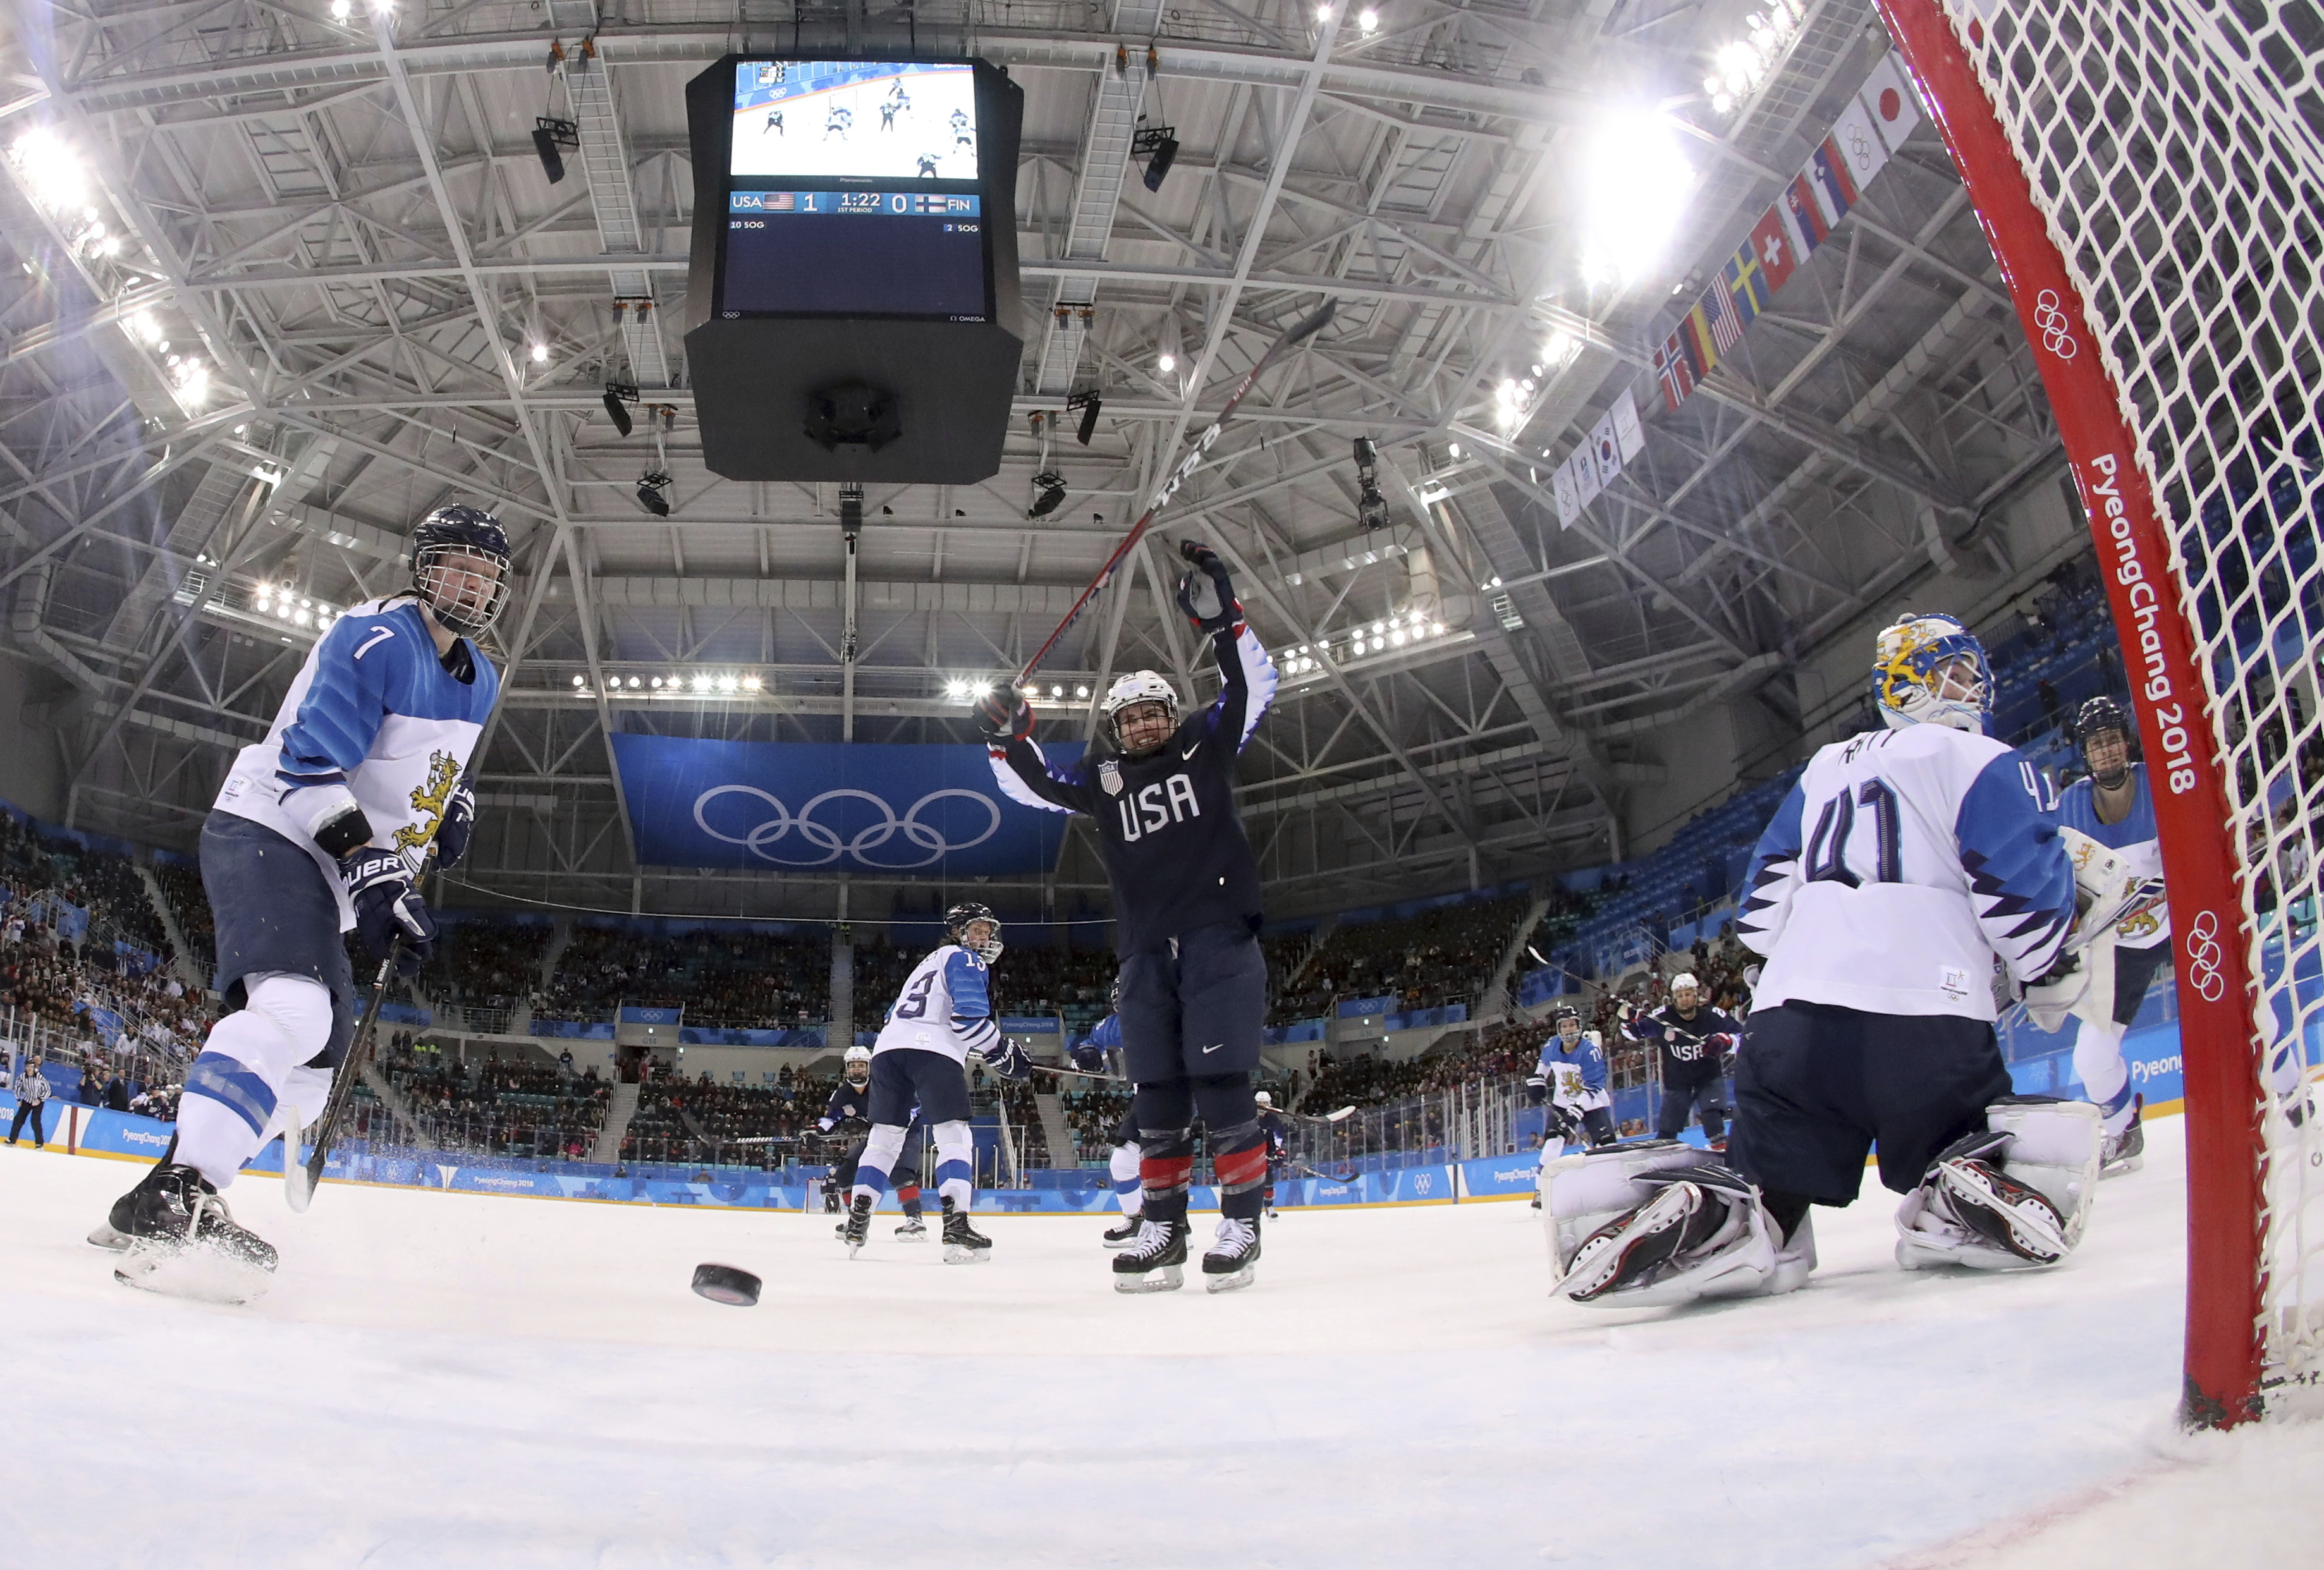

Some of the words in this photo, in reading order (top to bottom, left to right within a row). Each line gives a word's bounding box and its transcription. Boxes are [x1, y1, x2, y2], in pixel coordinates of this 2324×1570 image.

[733, 196, 762, 208] USA
[803, 193, 817, 212] 1
[841, 193, 881, 207] 1:22
[891, 194, 907, 214] 0
[948, 199, 971, 211] FIN
[2091, 453, 2172, 702] PyeongChang
[2155, 702, 2196, 794] 2018
[353, 626, 396, 660] 7
[1101, 765, 1115, 774] USA
[2018, 761, 2060, 812] 41
[1118, 774, 1201, 842] USA
[1805, 776, 1903, 890] 41
[963, 952, 987, 971] 13
[884, 970, 939, 1025] 3
[123, 1128, 161, 1147] PyeongChang
[160, 1135, 173, 1146] 201
[474, 1176, 518, 1188] PyeongChang
[1494, 1168, 1531, 1184] PyeongChang
